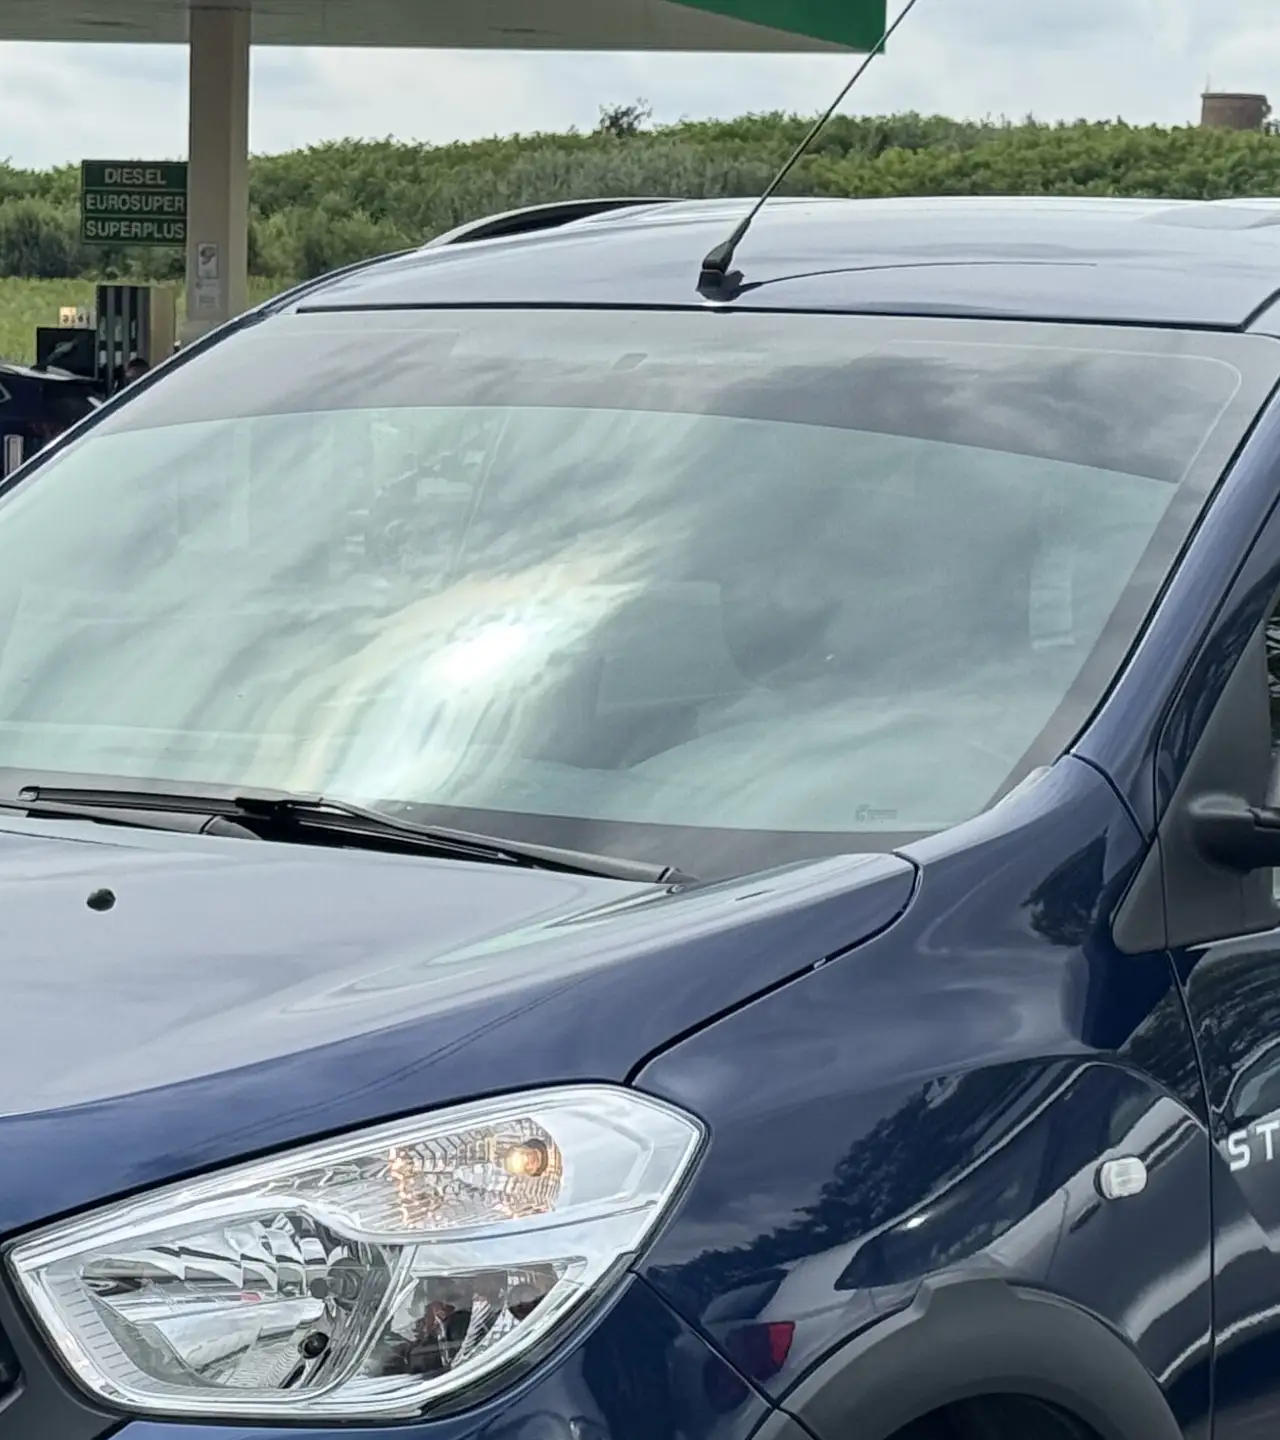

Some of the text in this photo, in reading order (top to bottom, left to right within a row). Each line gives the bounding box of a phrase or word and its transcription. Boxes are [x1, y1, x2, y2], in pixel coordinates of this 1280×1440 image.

[104, 168, 167, 185] DIESEL
[86, 193, 185, 213] EUROSUPER
[86, 220, 185, 239] SUPERPLUS
